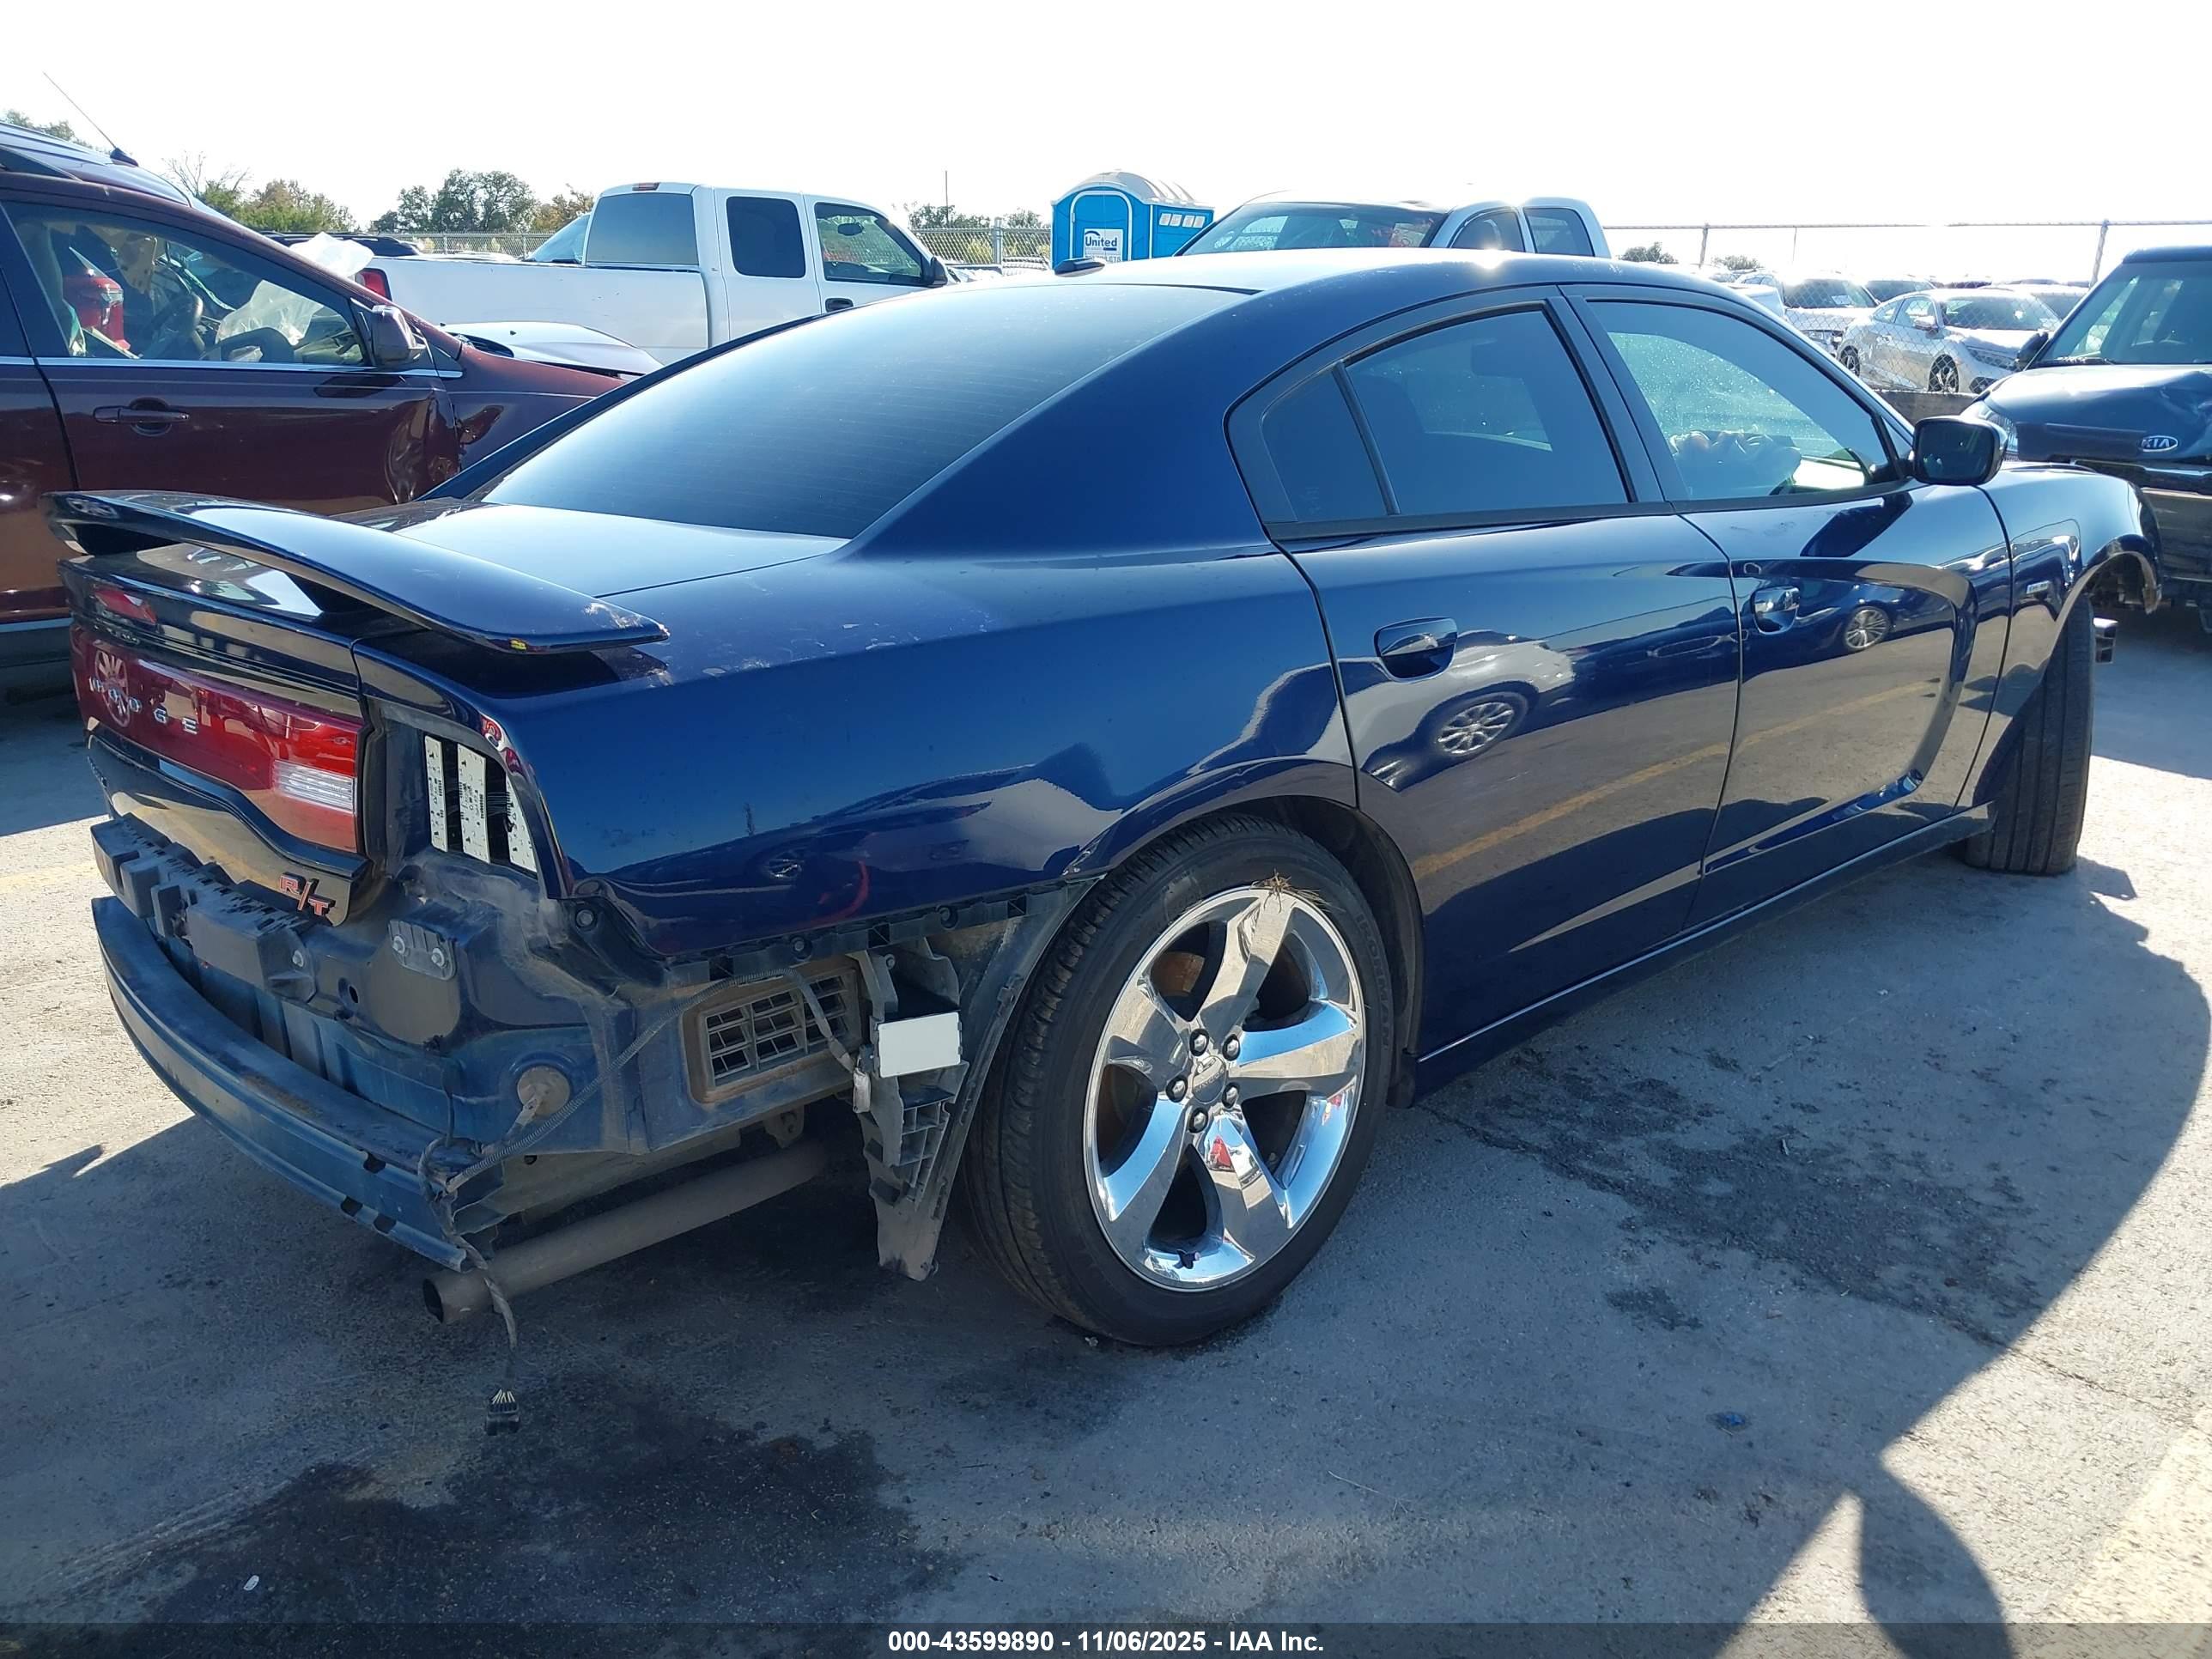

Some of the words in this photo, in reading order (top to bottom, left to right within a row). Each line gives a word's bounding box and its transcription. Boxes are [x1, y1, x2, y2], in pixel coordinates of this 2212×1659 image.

[1085, 236, 1118, 246] United
[2142, 438, 2170, 448] KIA
[279, 873, 334, 916] R/T
